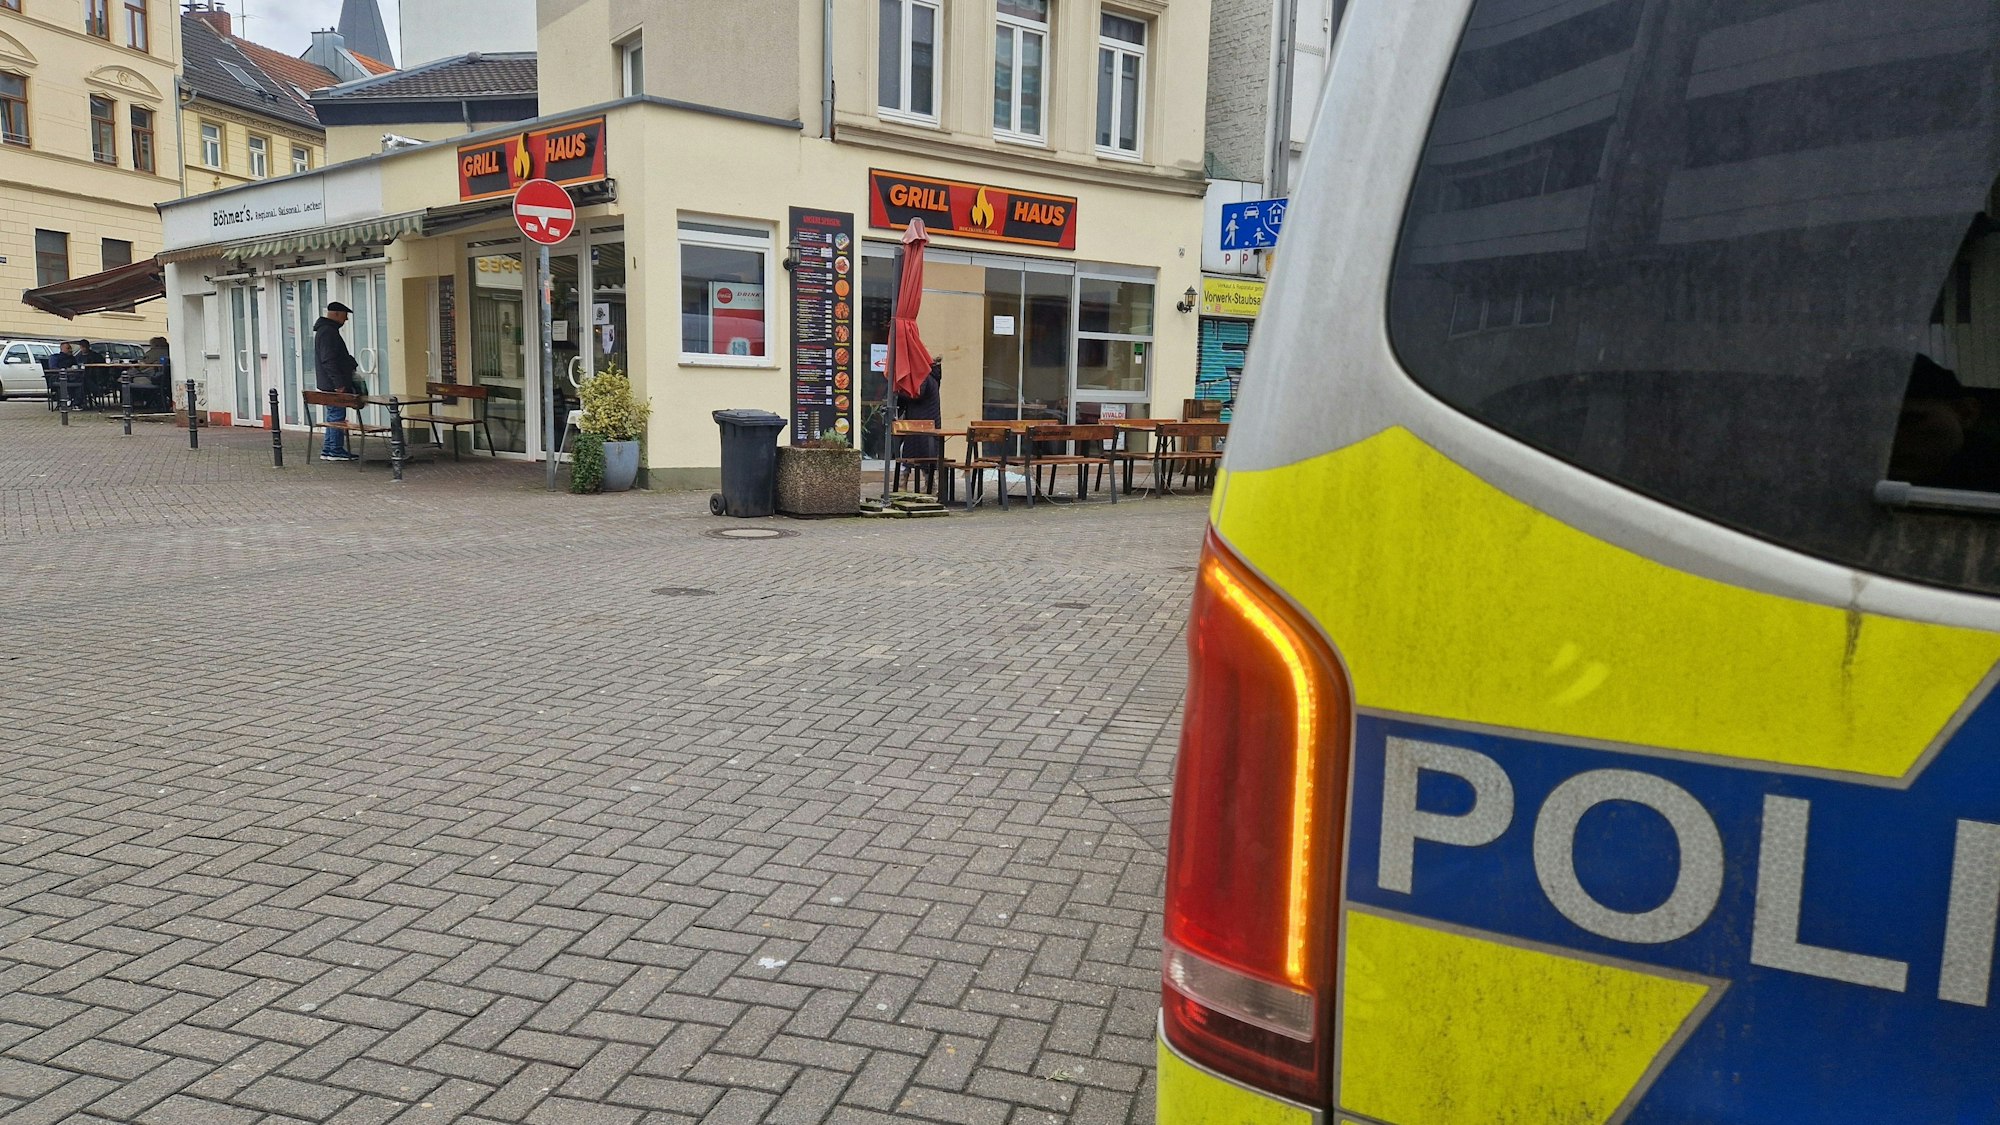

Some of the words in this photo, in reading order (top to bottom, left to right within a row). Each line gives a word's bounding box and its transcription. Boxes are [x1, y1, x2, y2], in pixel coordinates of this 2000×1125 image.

[463, 150, 499, 177] GRILL
[545, 132, 587, 162] HAUS
[889, 184, 949, 212] GRILL
[1014, 201, 1066, 227] HAUS
[1378, 736, 2000, 1007] POLI
